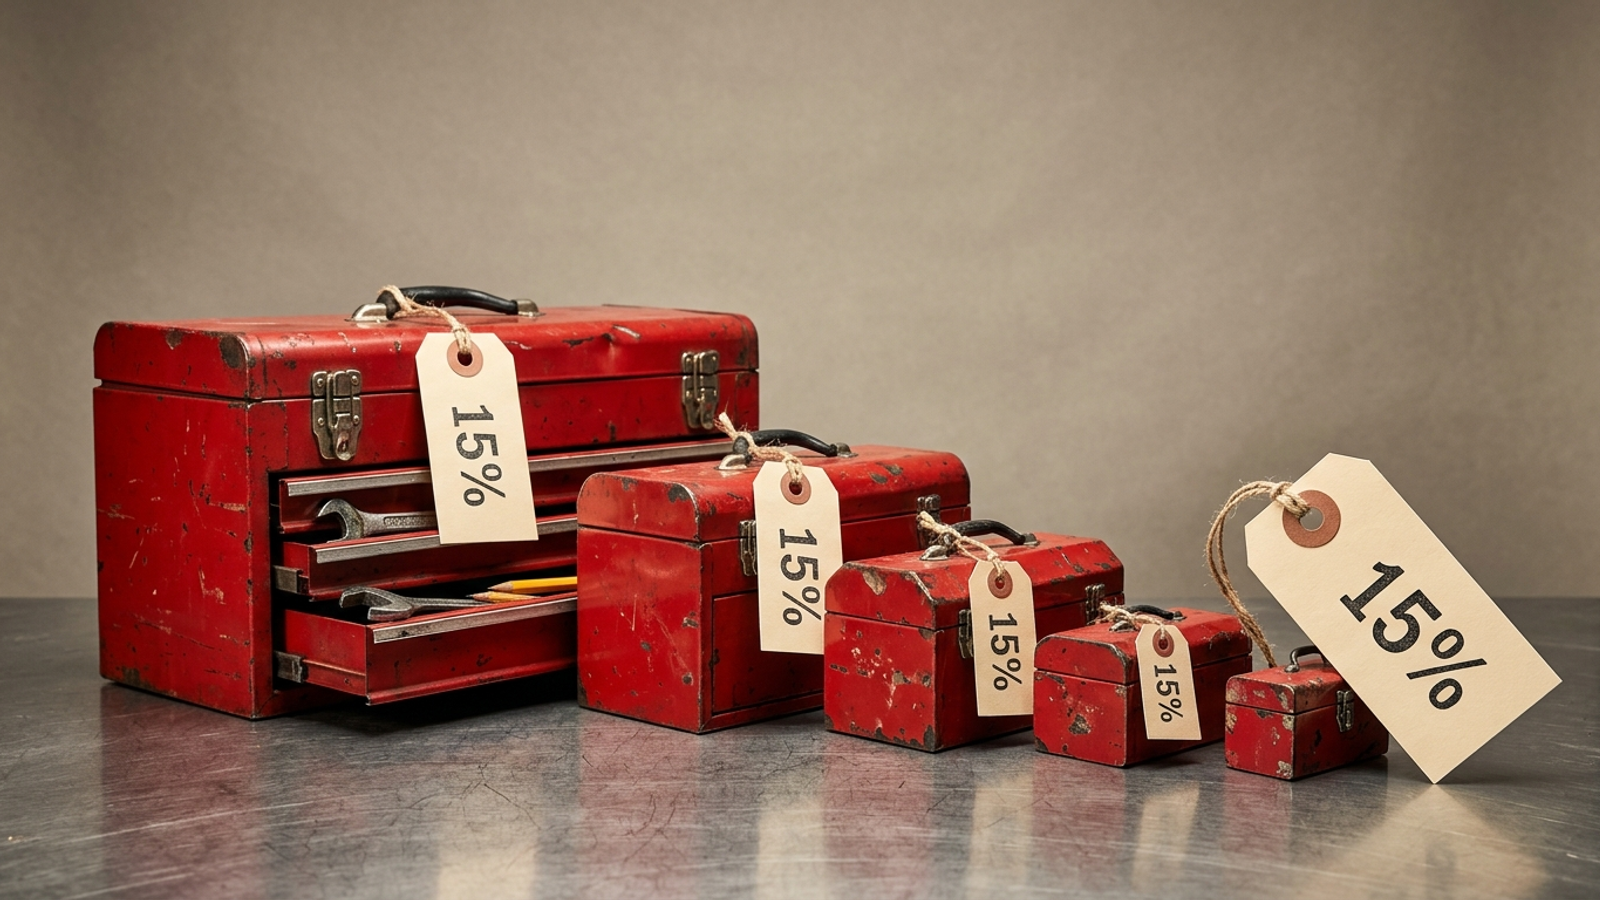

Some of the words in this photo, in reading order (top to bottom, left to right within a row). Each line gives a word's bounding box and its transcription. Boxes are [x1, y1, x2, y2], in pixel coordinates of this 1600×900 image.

[451, 405, 506, 507] 15%
[779, 528, 822, 626] 15%
[988, 612, 1023, 691] 15%
[1339, 561, 1488, 710] 15%
[1153, 663, 1184, 723] 15%
